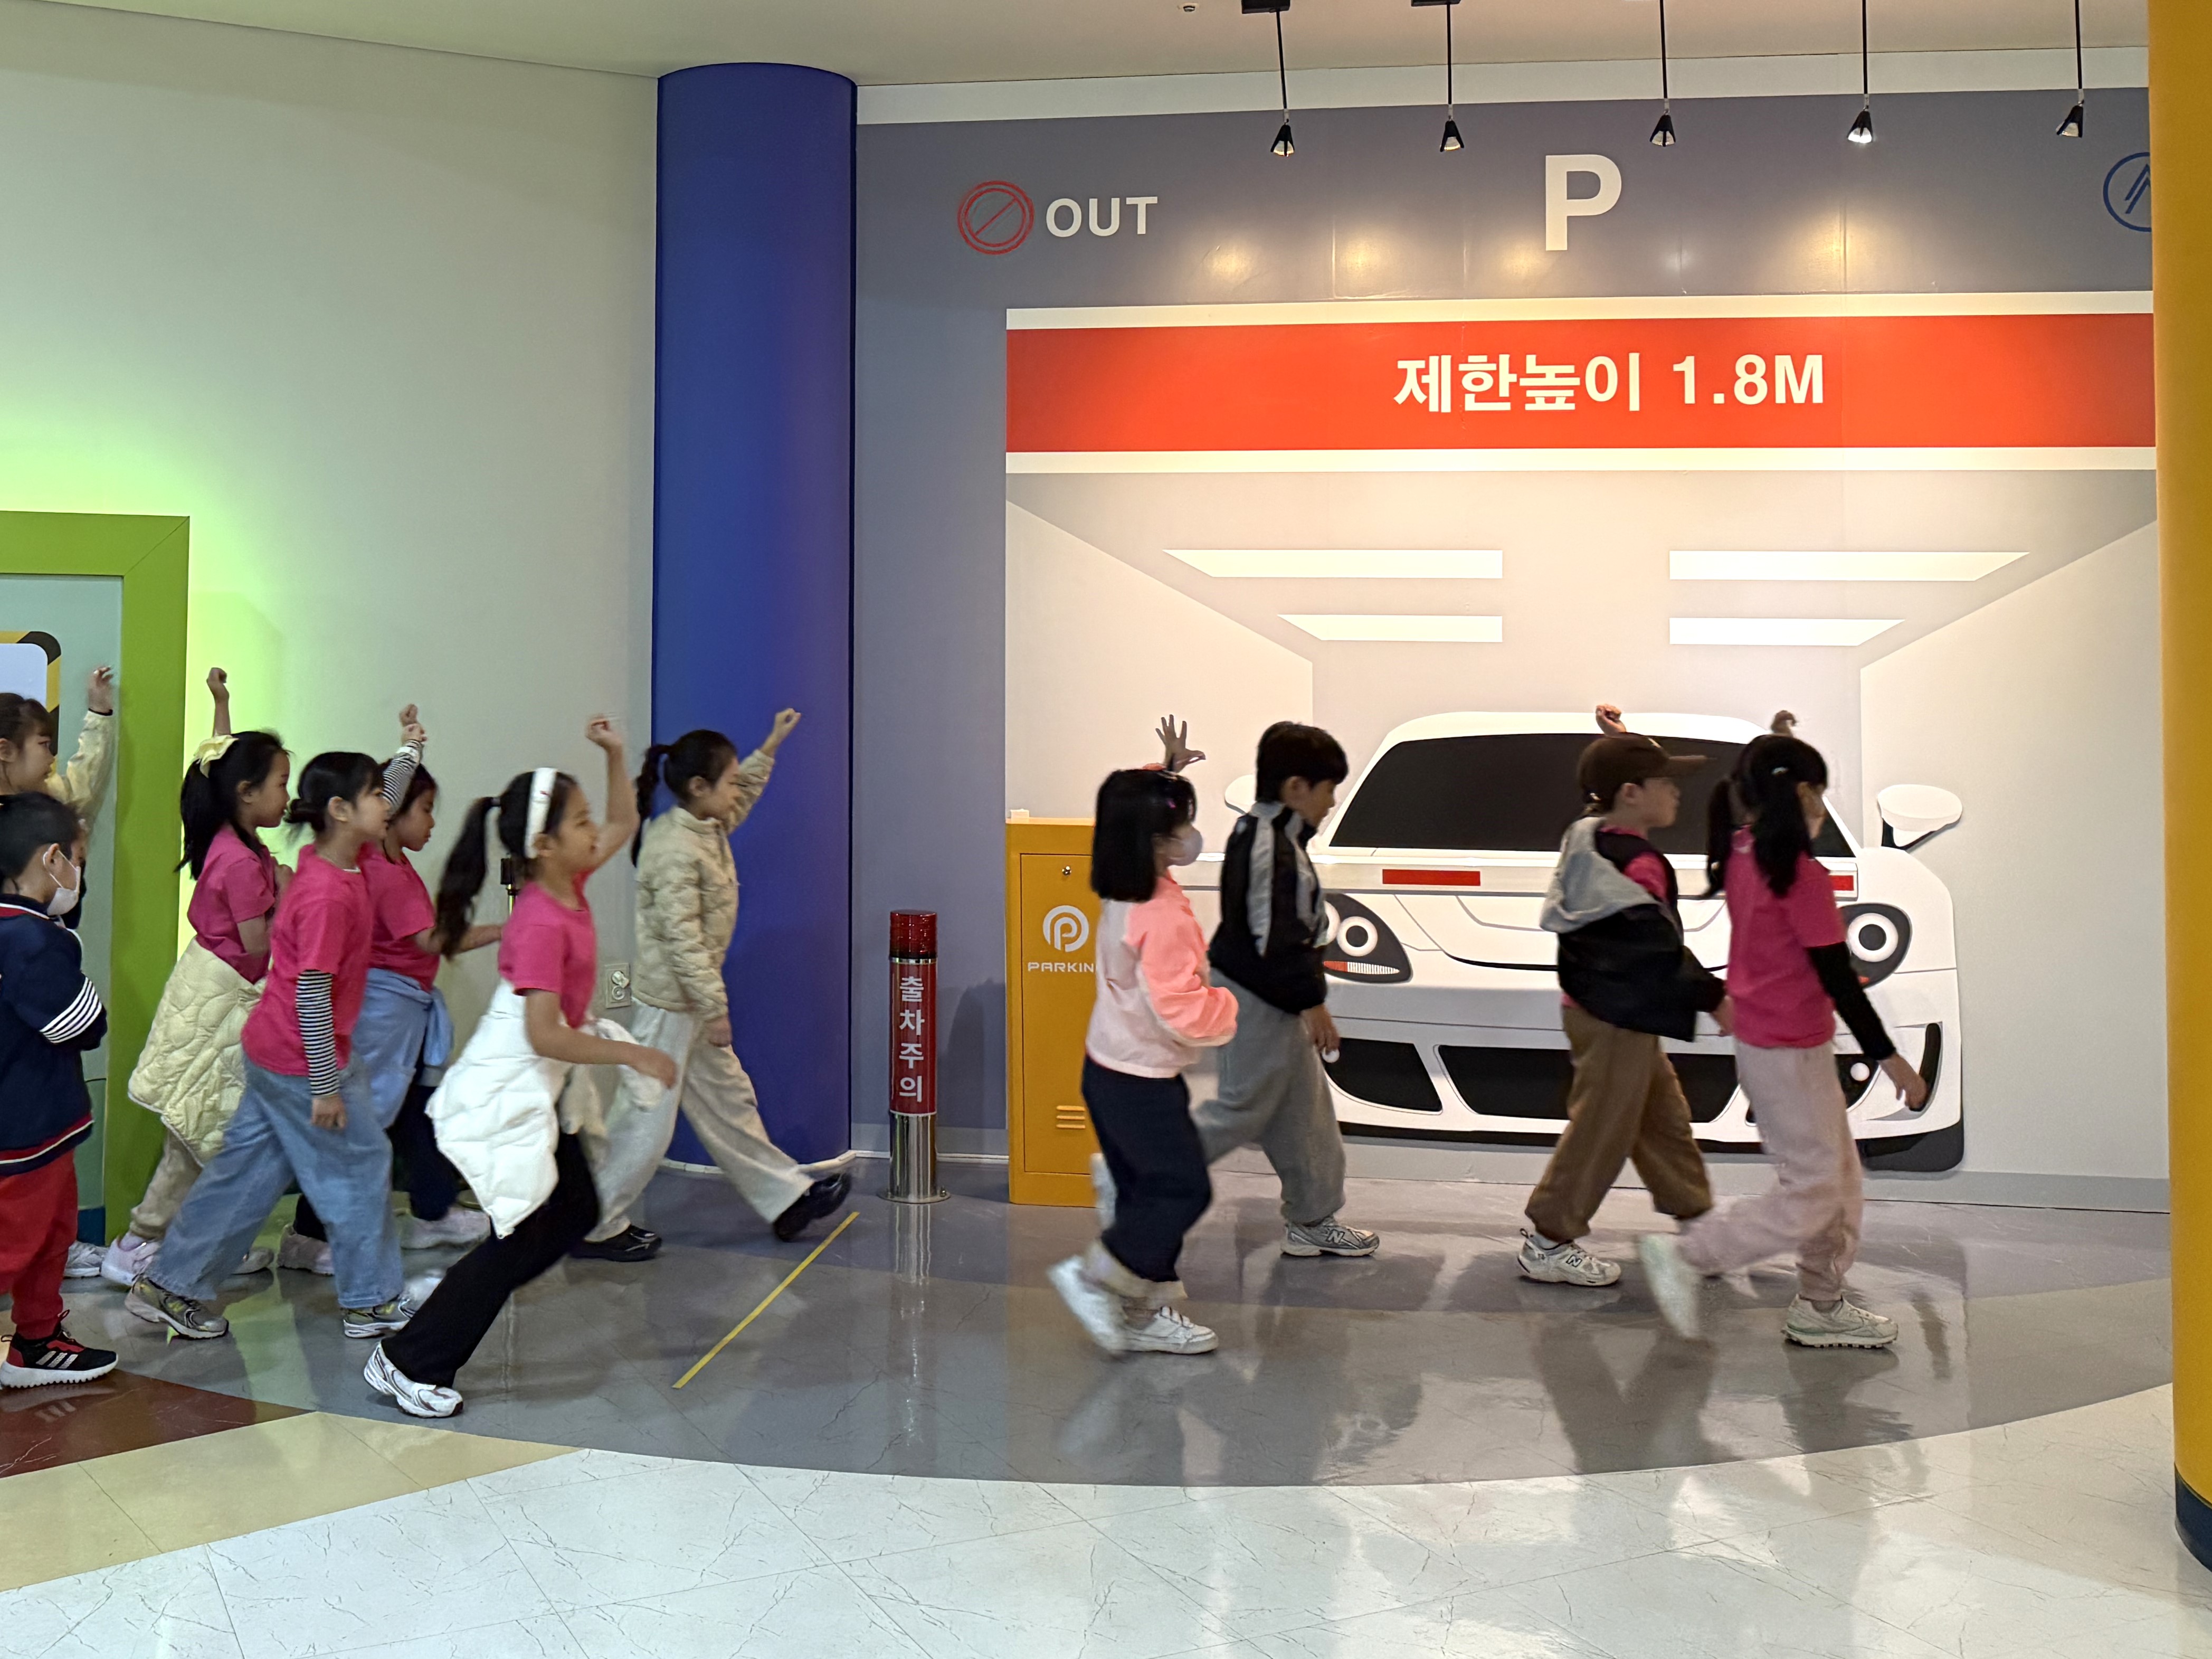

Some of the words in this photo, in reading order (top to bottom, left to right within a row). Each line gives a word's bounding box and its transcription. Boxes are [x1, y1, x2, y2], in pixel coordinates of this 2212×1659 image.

[1046, 196, 1158, 238] OUT
[1545, 155, 1622, 251] P
[1394, 353, 1640, 413] 제한높이
[1673, 354, 1824, 404] 1.8M
[1028, 962, 1096, 973] PARKIN
[899, 976, 925, 1103] 출차주의
